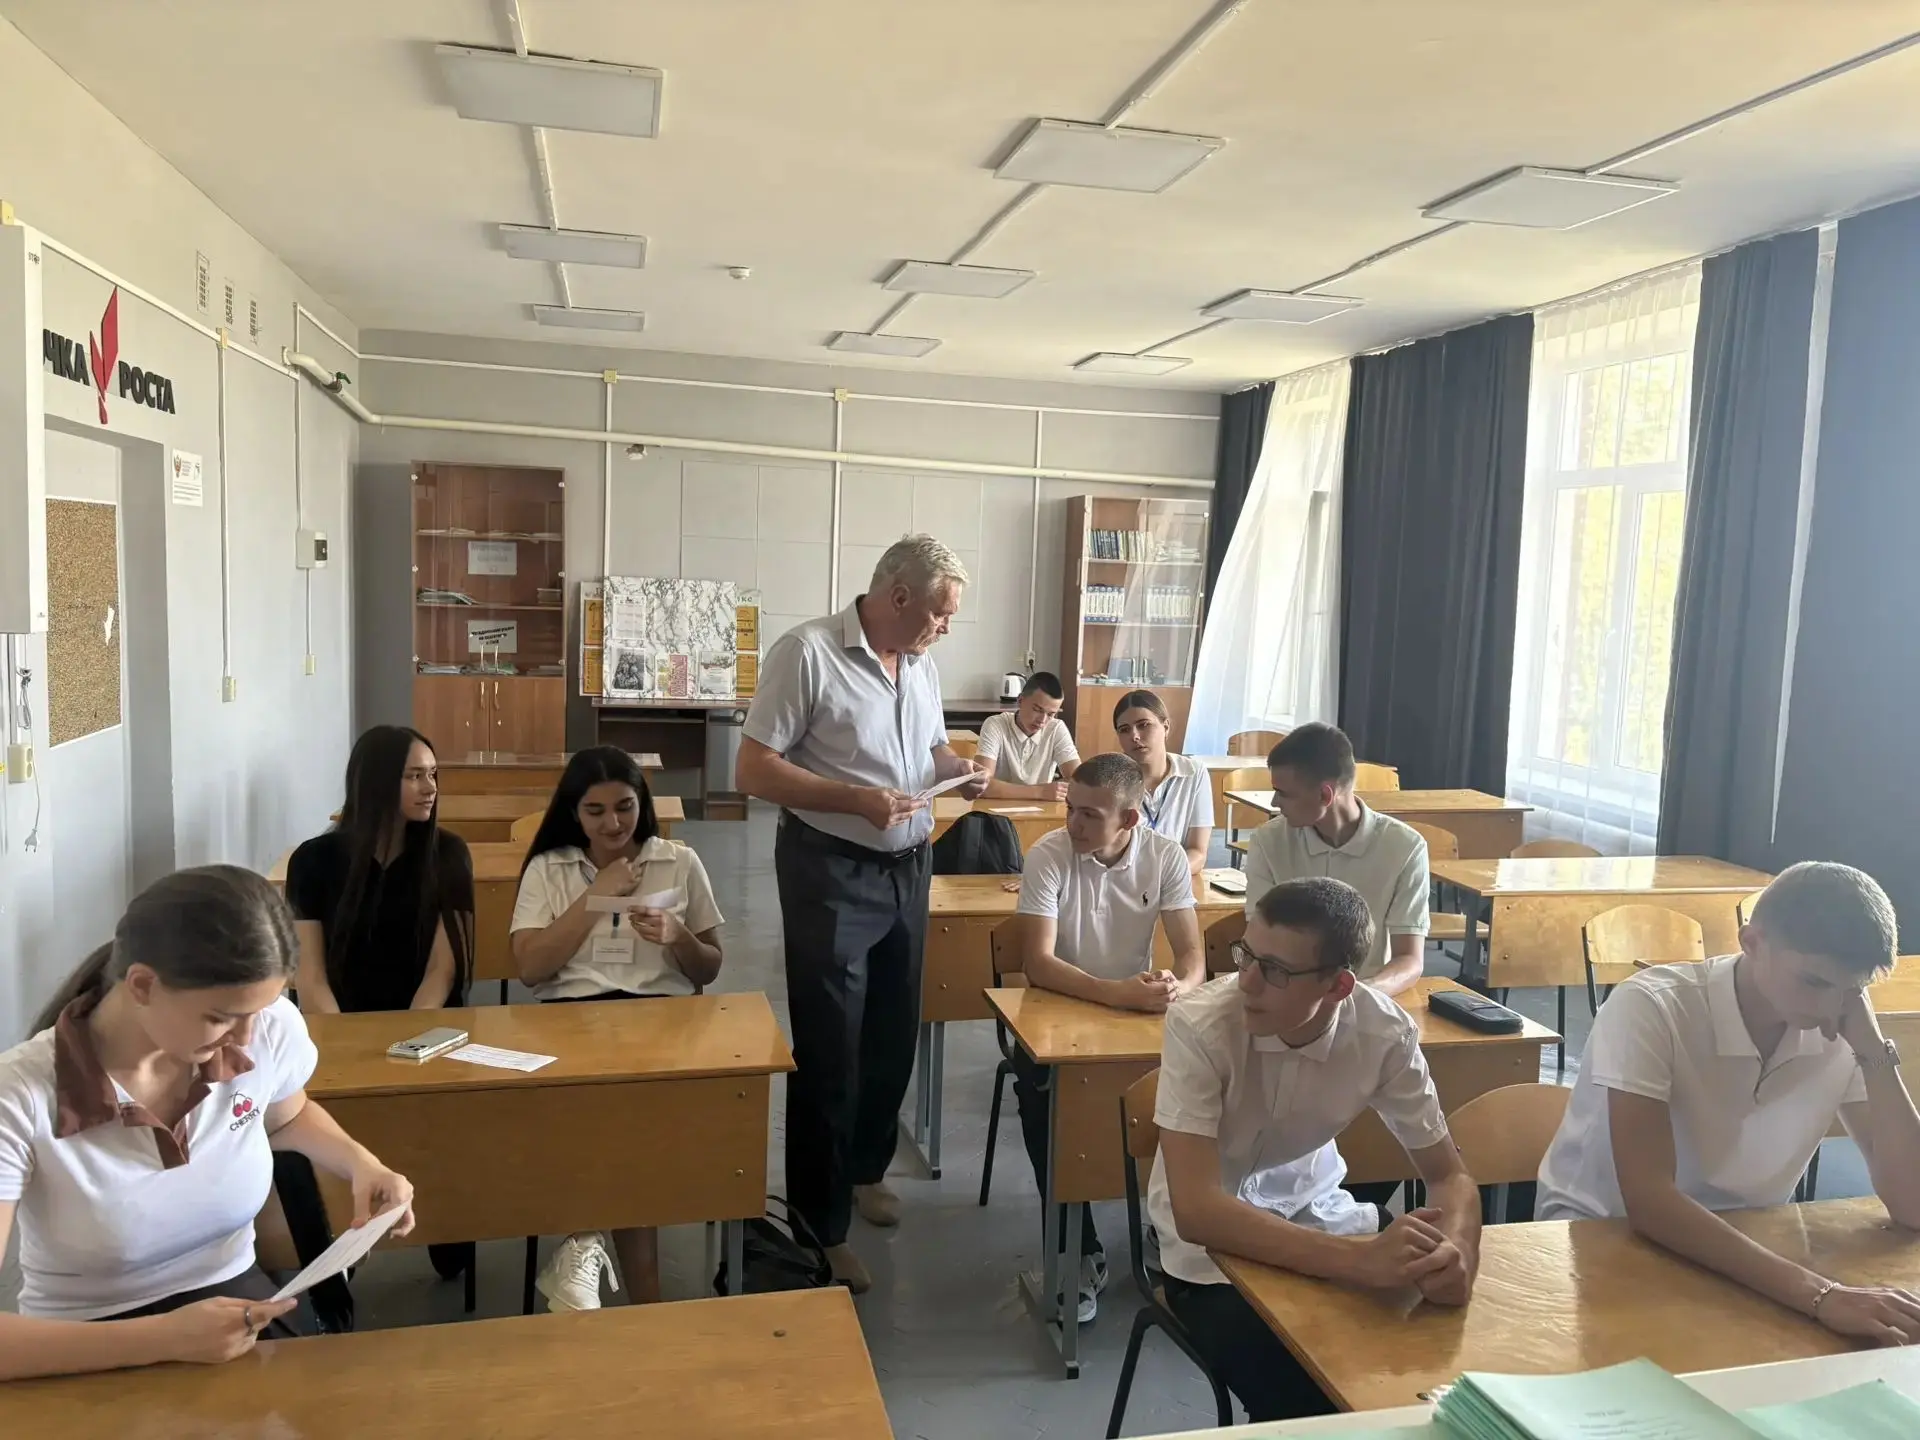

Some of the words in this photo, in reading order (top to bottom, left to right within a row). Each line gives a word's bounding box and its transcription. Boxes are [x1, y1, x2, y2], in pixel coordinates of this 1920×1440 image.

[43, 328, 90, 386] ЧКА
[118, 360, 176, 414] РОСТА
[229, 1106, 261, 1132] CHERRY
